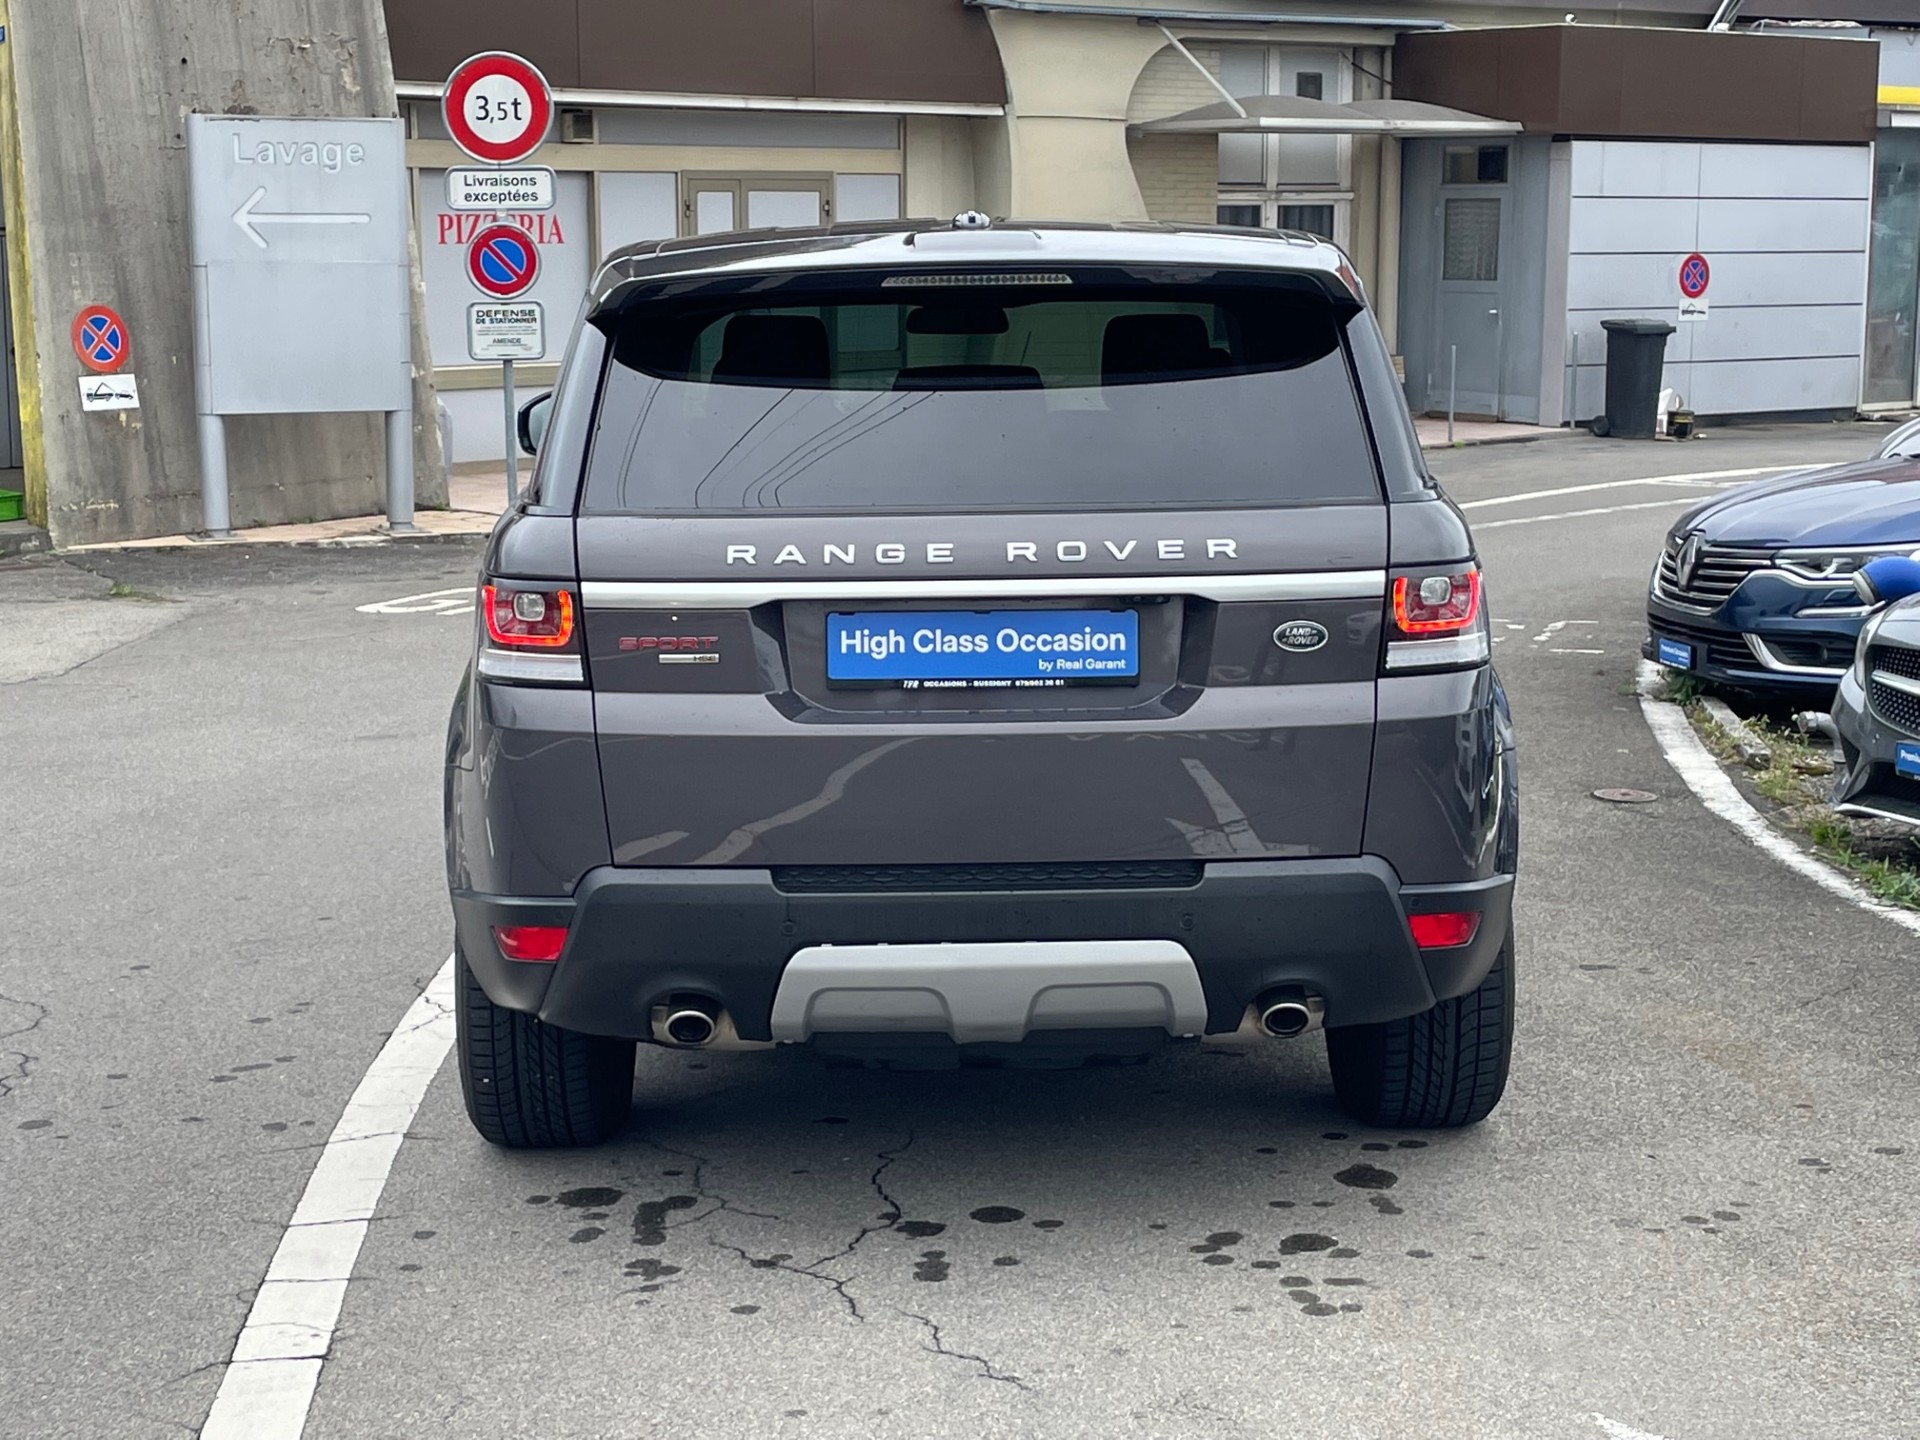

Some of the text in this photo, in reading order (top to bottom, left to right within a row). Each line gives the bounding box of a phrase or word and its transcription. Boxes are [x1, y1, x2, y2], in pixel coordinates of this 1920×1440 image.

[232, 132, 365, 174] Lavage
[464, 174, 537, 187] Livraisons
[464, 189, 539, 204] exceptées
[726, 538, 1239, 565] RANGE ROVER
[619, 636, 719, 650] SPORT
[841, 626, 1126, 660] High Class Occasion
[1038, 657, 1126, 672] by Real Garant
